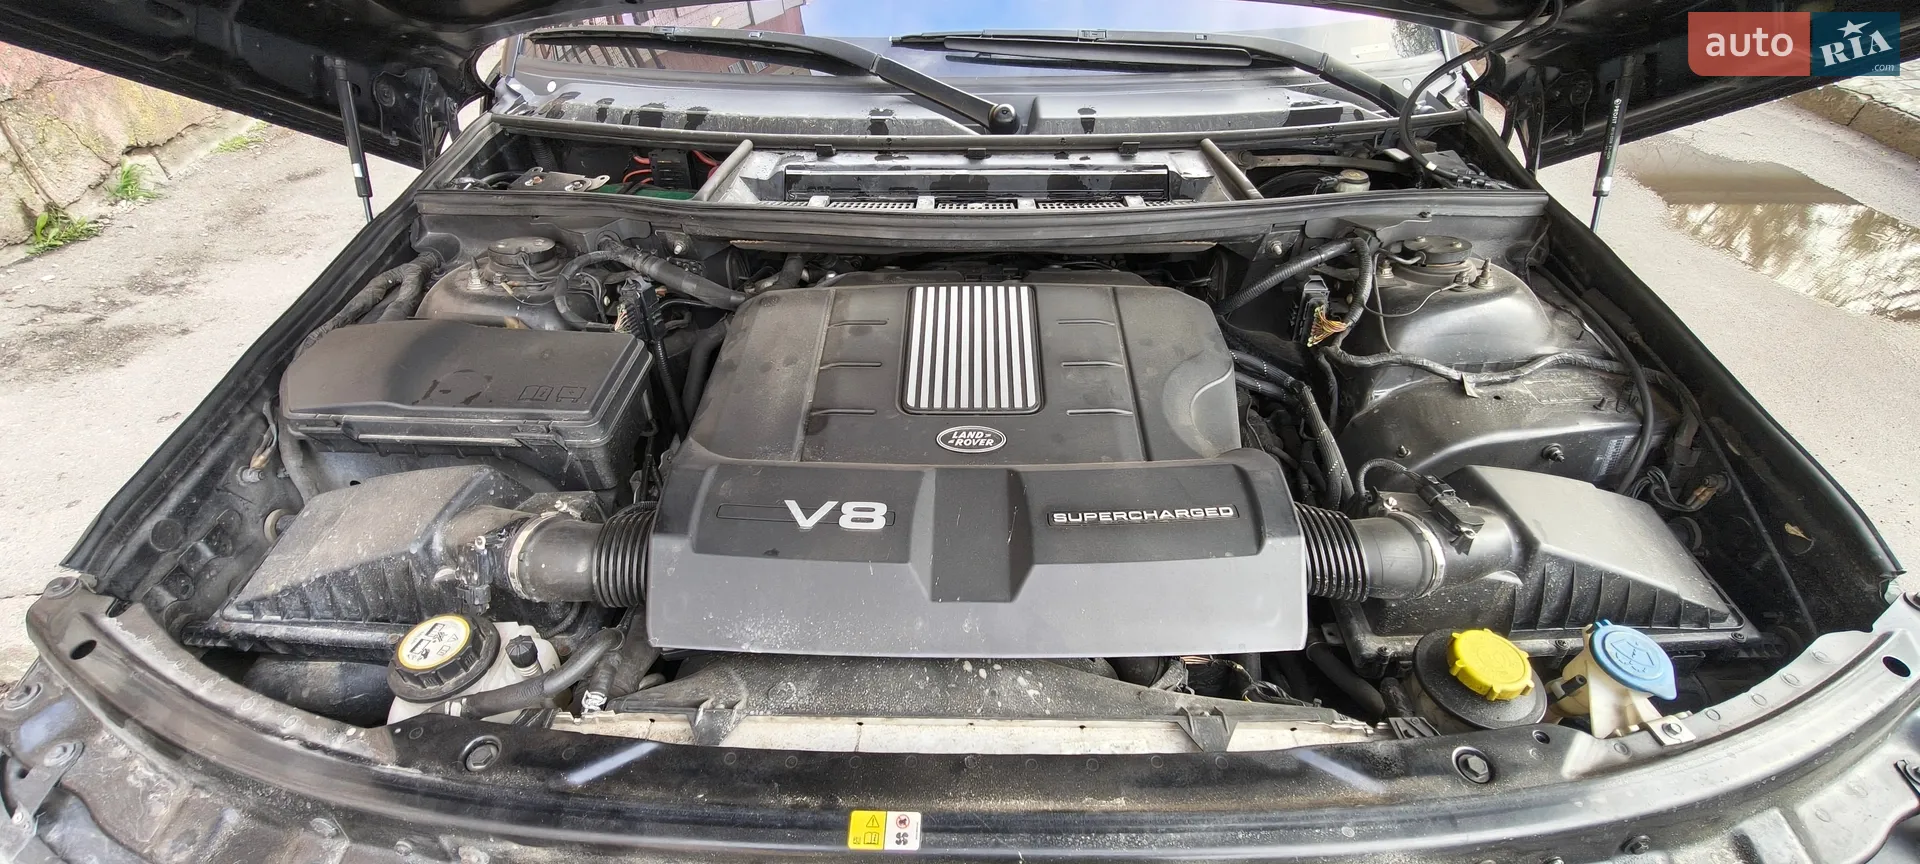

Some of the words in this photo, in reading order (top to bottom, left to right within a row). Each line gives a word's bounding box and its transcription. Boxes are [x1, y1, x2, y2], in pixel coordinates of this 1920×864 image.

[952, 431, 984, 439] LAND
[784, 500, 888, 530] V8
[1053, 506, 1234, 523] SUPERCHARGED
